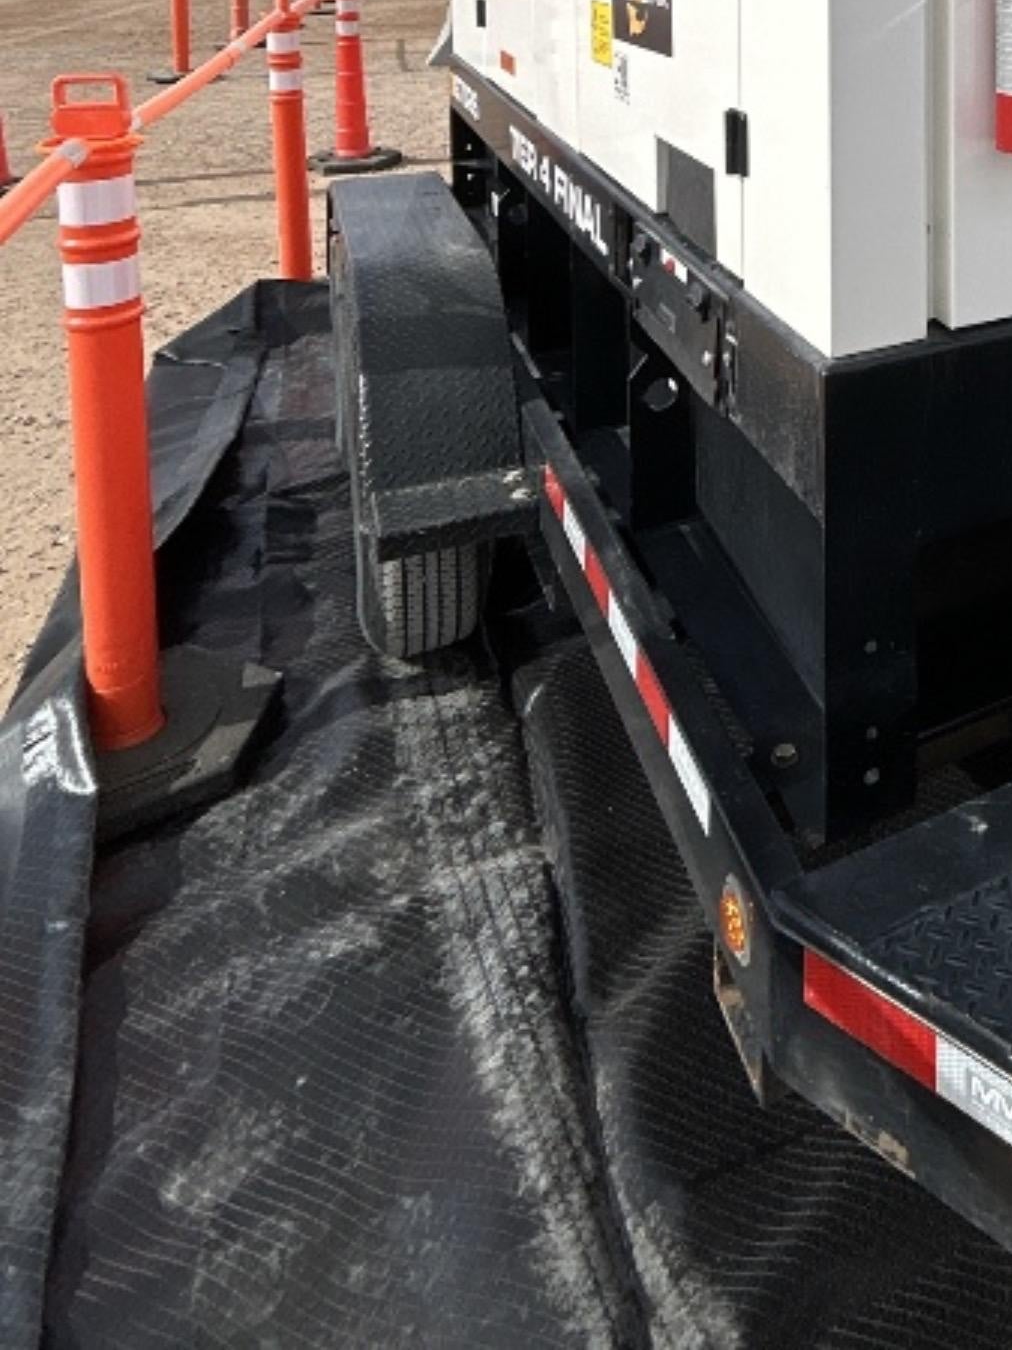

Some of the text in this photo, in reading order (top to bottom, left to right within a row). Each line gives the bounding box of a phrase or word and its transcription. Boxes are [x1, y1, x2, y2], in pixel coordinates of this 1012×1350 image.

[508, 125, 609, 256] TIER 4 FINAL
